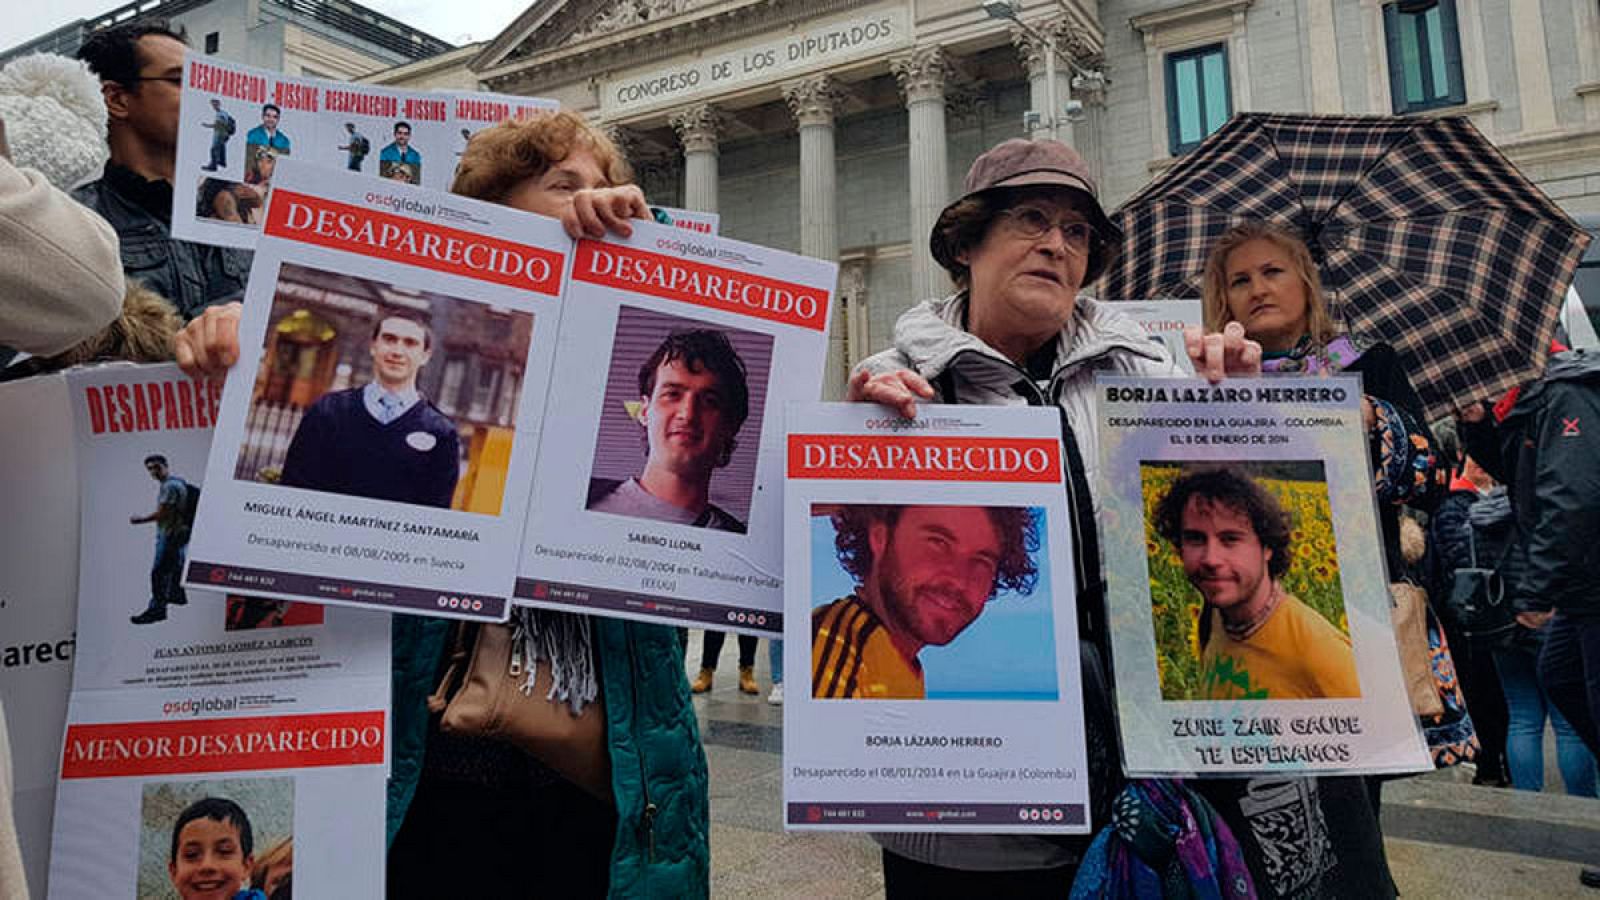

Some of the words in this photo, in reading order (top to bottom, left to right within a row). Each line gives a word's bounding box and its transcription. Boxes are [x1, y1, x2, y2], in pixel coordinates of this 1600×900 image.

[617, 69, 700, 103] CONGRESO
[711, 61, 732, 81] DE
[743, 50, 776, 73] LOS
[788, 18, 892, 61] DIPUTADOS
[190, 61, 267, 104] DESAPARECIDO
[325, 90, 397, 117] DESAPARECIDO
[285, 203, 551, 283] DESAPARECIDO
[590, 250, 817, 319] DESAPARECIDO
[1106, 387, 1168, 402] BORJA
[1255, 387, 1347, 402] HERRERO
[1108, 417, 1192, 427] DESAPARECIDO
[1194, 417, 1209, 427] EN
[1211, 417, 1225, 427] LA
[1227, 417, 1277, 427] GUAJIRA
[1170, 435, 1184, 444] EL
[1186, 435, 1192, 444] 8
[1194, 435, 1209, 444] DE
[1211, 435, 1249, 444] ENERO
[1251, 435, 1266, 444] DE
[802, 442, 1050, 473] DESAPARECIDO
[243, 502, 293, 518] MIGUEL
[247, 533, 329, 554] Desaparecido
[330, 544, 342, 555] el
[413, 555, 428, 565] en
[431, 557, 465, 571] Suecia
[535, 544, 604, 563] Desaparecido
[606, 554, 617, 564] el
[677, 565, 690, 575] en
[1172, 716, 1226, 738] ZURE
[1232, 716, 1282, 737] ZAIN
[1290, 715, 1363, 735] GAUDE
[71, 735, 172, 762] MENOR
[178, 725, 382, 758] DESAPARECIDO
[865, 736, 902, 747] BORJA
[951, 736, 1003, 747] HERRERO
[1196, 747, 1224, 765] TE
[1231, 744, 1353, 765] ESPERAMOS
[793, 767, 866, 780] Desaparecido
[868, 768, 878, 777] el
[946, 770, 960, 778] en
[963, 768, 975, 778] La
[977, 768, 1017, 780] Guajira
[1019, 767, 1077, 780] (Colombia)
